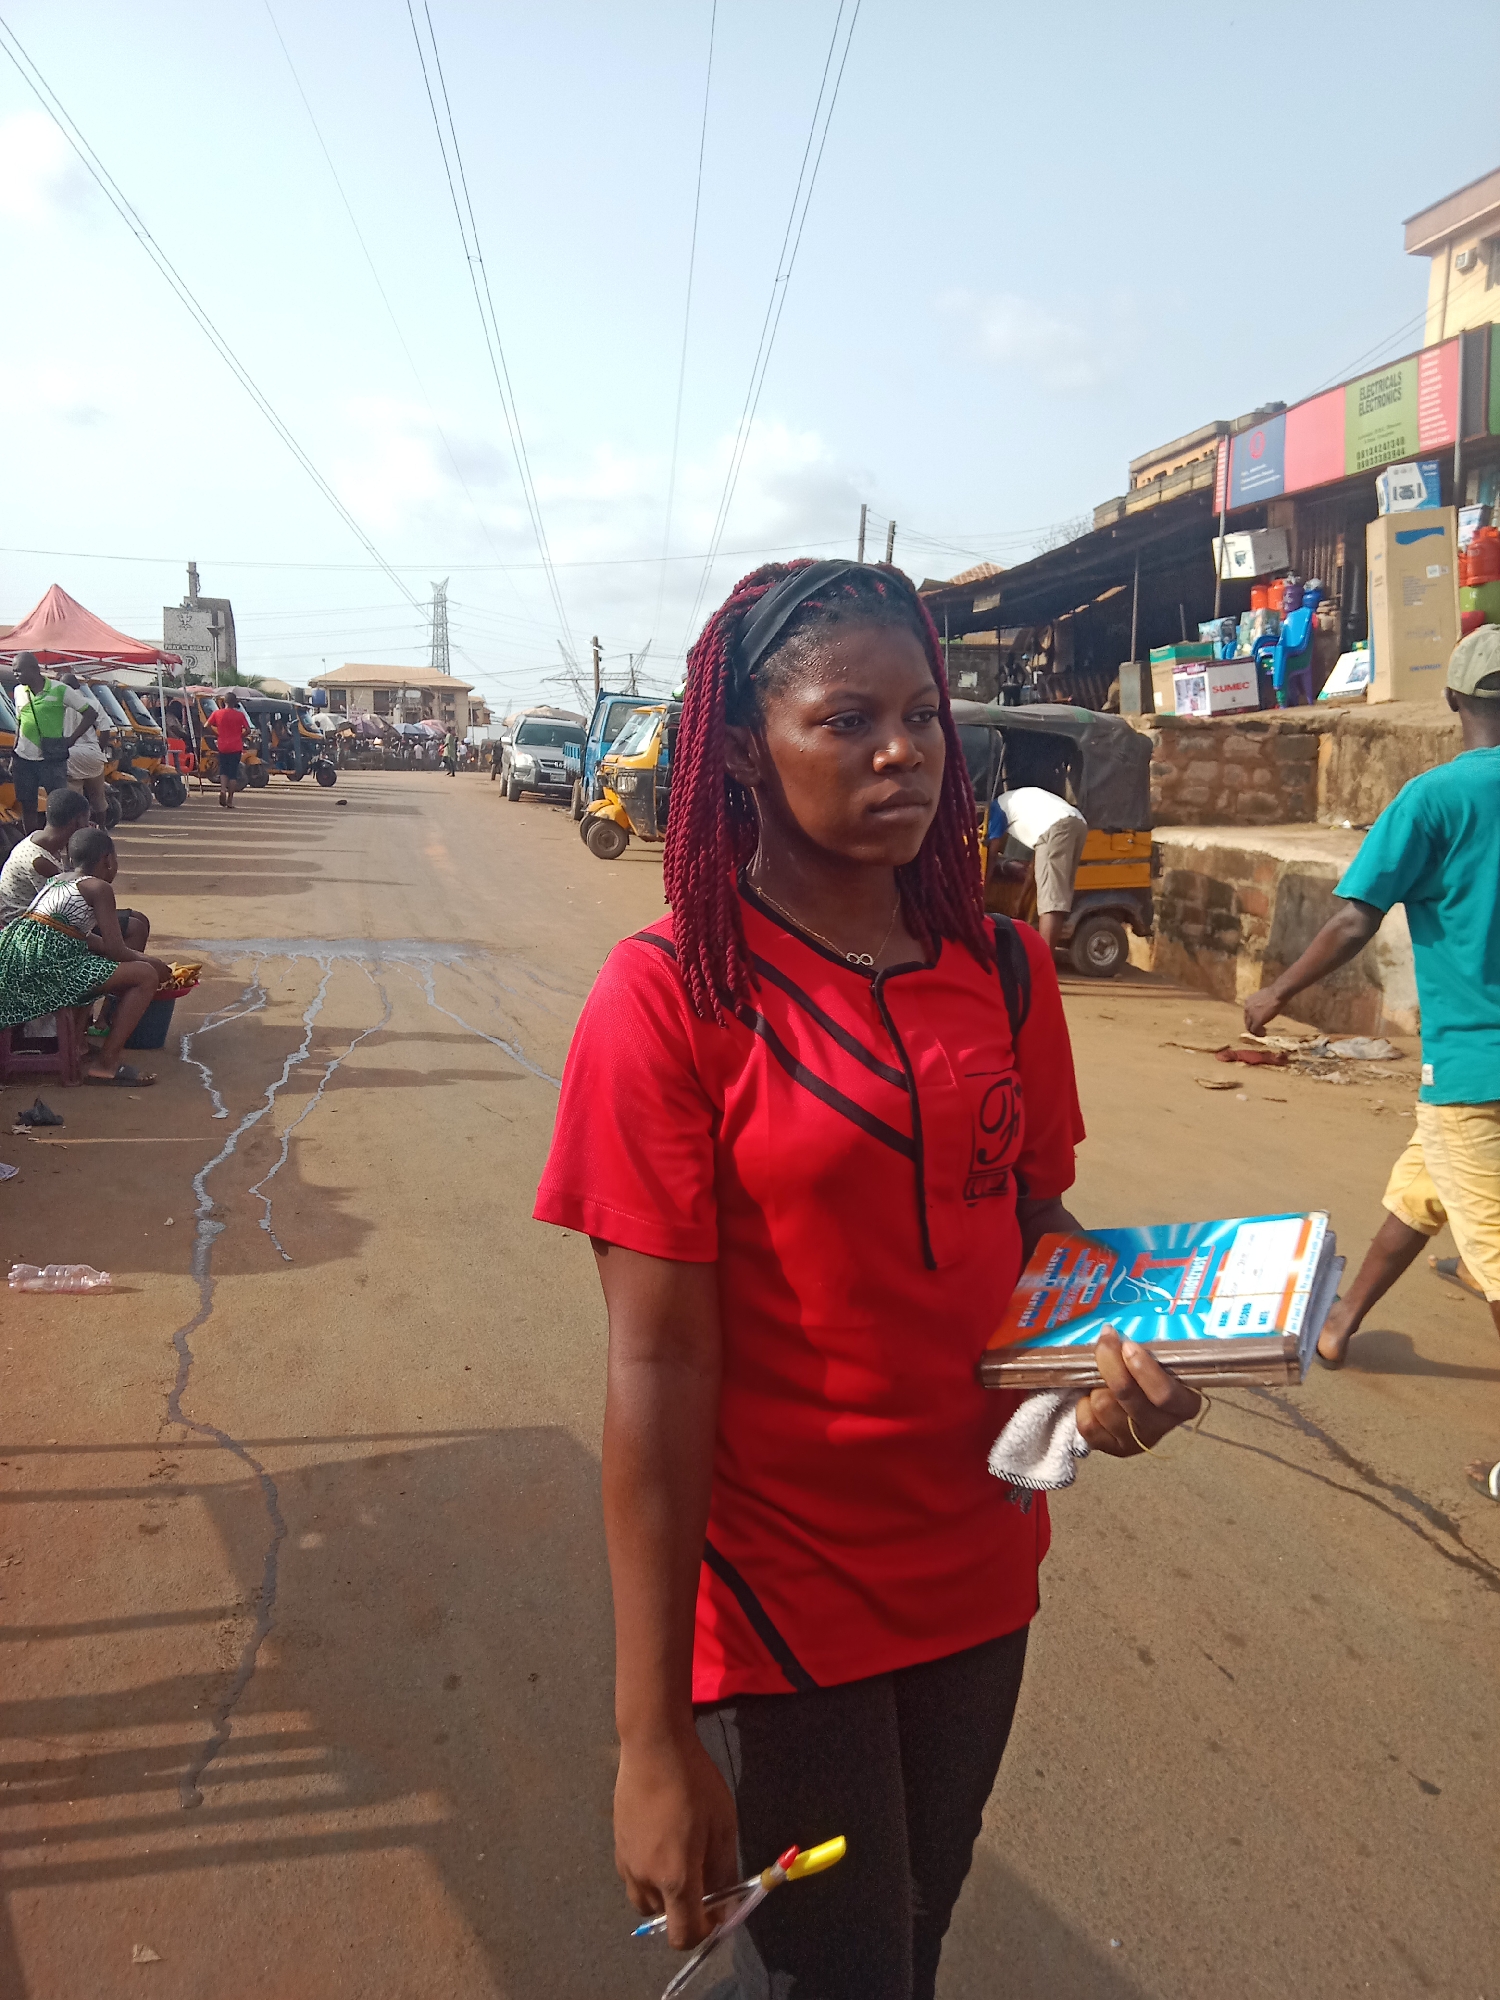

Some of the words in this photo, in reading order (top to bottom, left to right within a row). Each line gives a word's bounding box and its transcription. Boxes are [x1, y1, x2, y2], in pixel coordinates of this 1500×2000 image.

[1360, 371, 1401, 400] ELECTRICALS
[1359, 387, 1401, 416] ELECTRONICS
[1212, 681, 1249, 693] SUMEC
